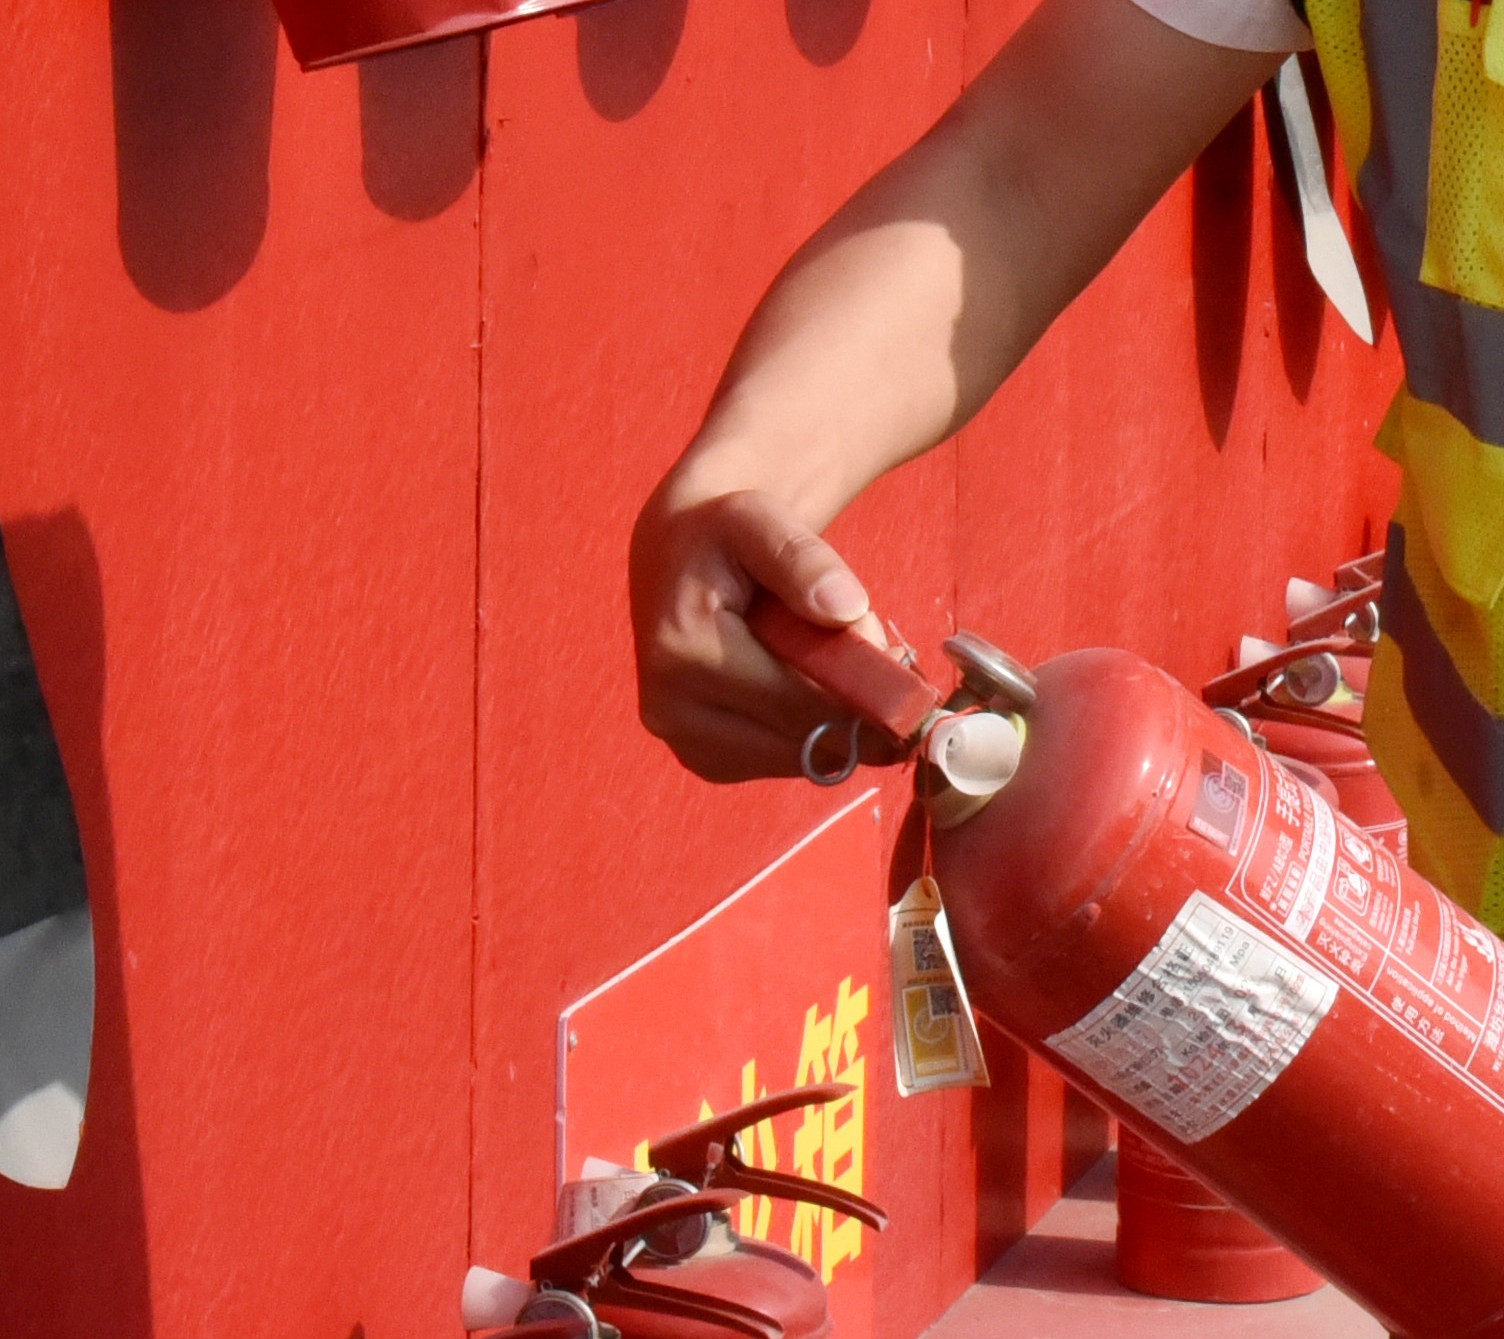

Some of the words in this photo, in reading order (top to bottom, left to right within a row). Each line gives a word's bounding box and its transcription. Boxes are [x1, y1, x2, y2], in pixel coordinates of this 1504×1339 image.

[1229, 940, 1251, 968] Mpa
[1316, 932, 1366, 976] 灭火种类
[1275, 966, 1288, 980] 日
[1389, 991, 1446, 1046] 使用方法
